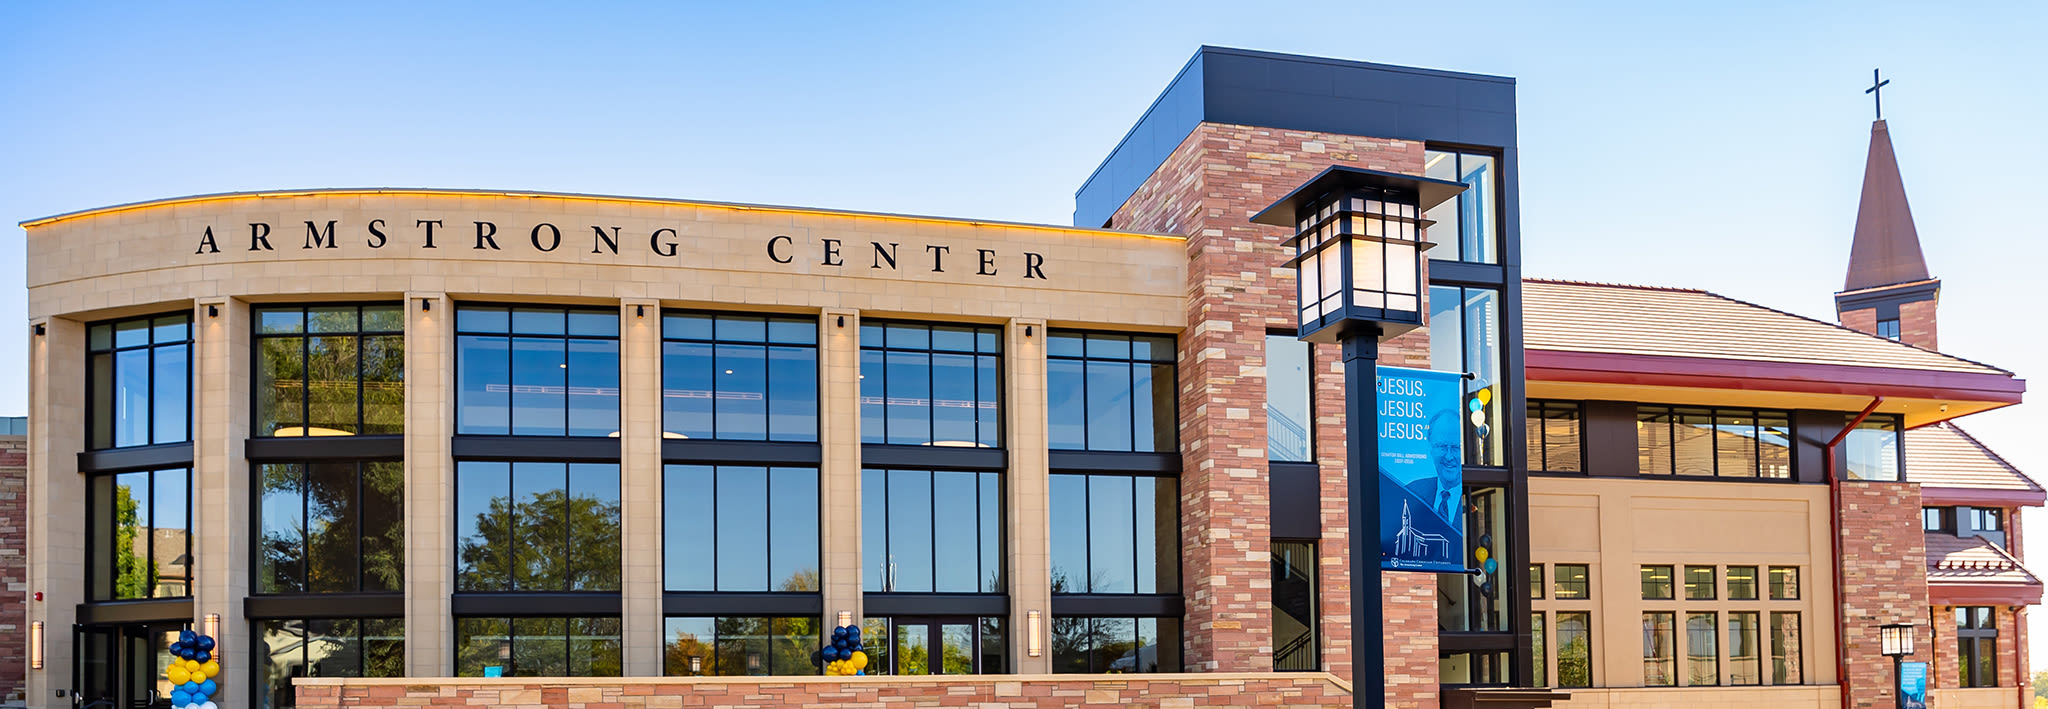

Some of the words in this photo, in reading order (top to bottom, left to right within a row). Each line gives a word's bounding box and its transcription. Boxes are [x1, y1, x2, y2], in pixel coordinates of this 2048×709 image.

[195, 219, 680, 257] ARMSTRONG
[766, 235, 1049, 281] CENTER
[1380, 400, 1426, 419] JESUS.
